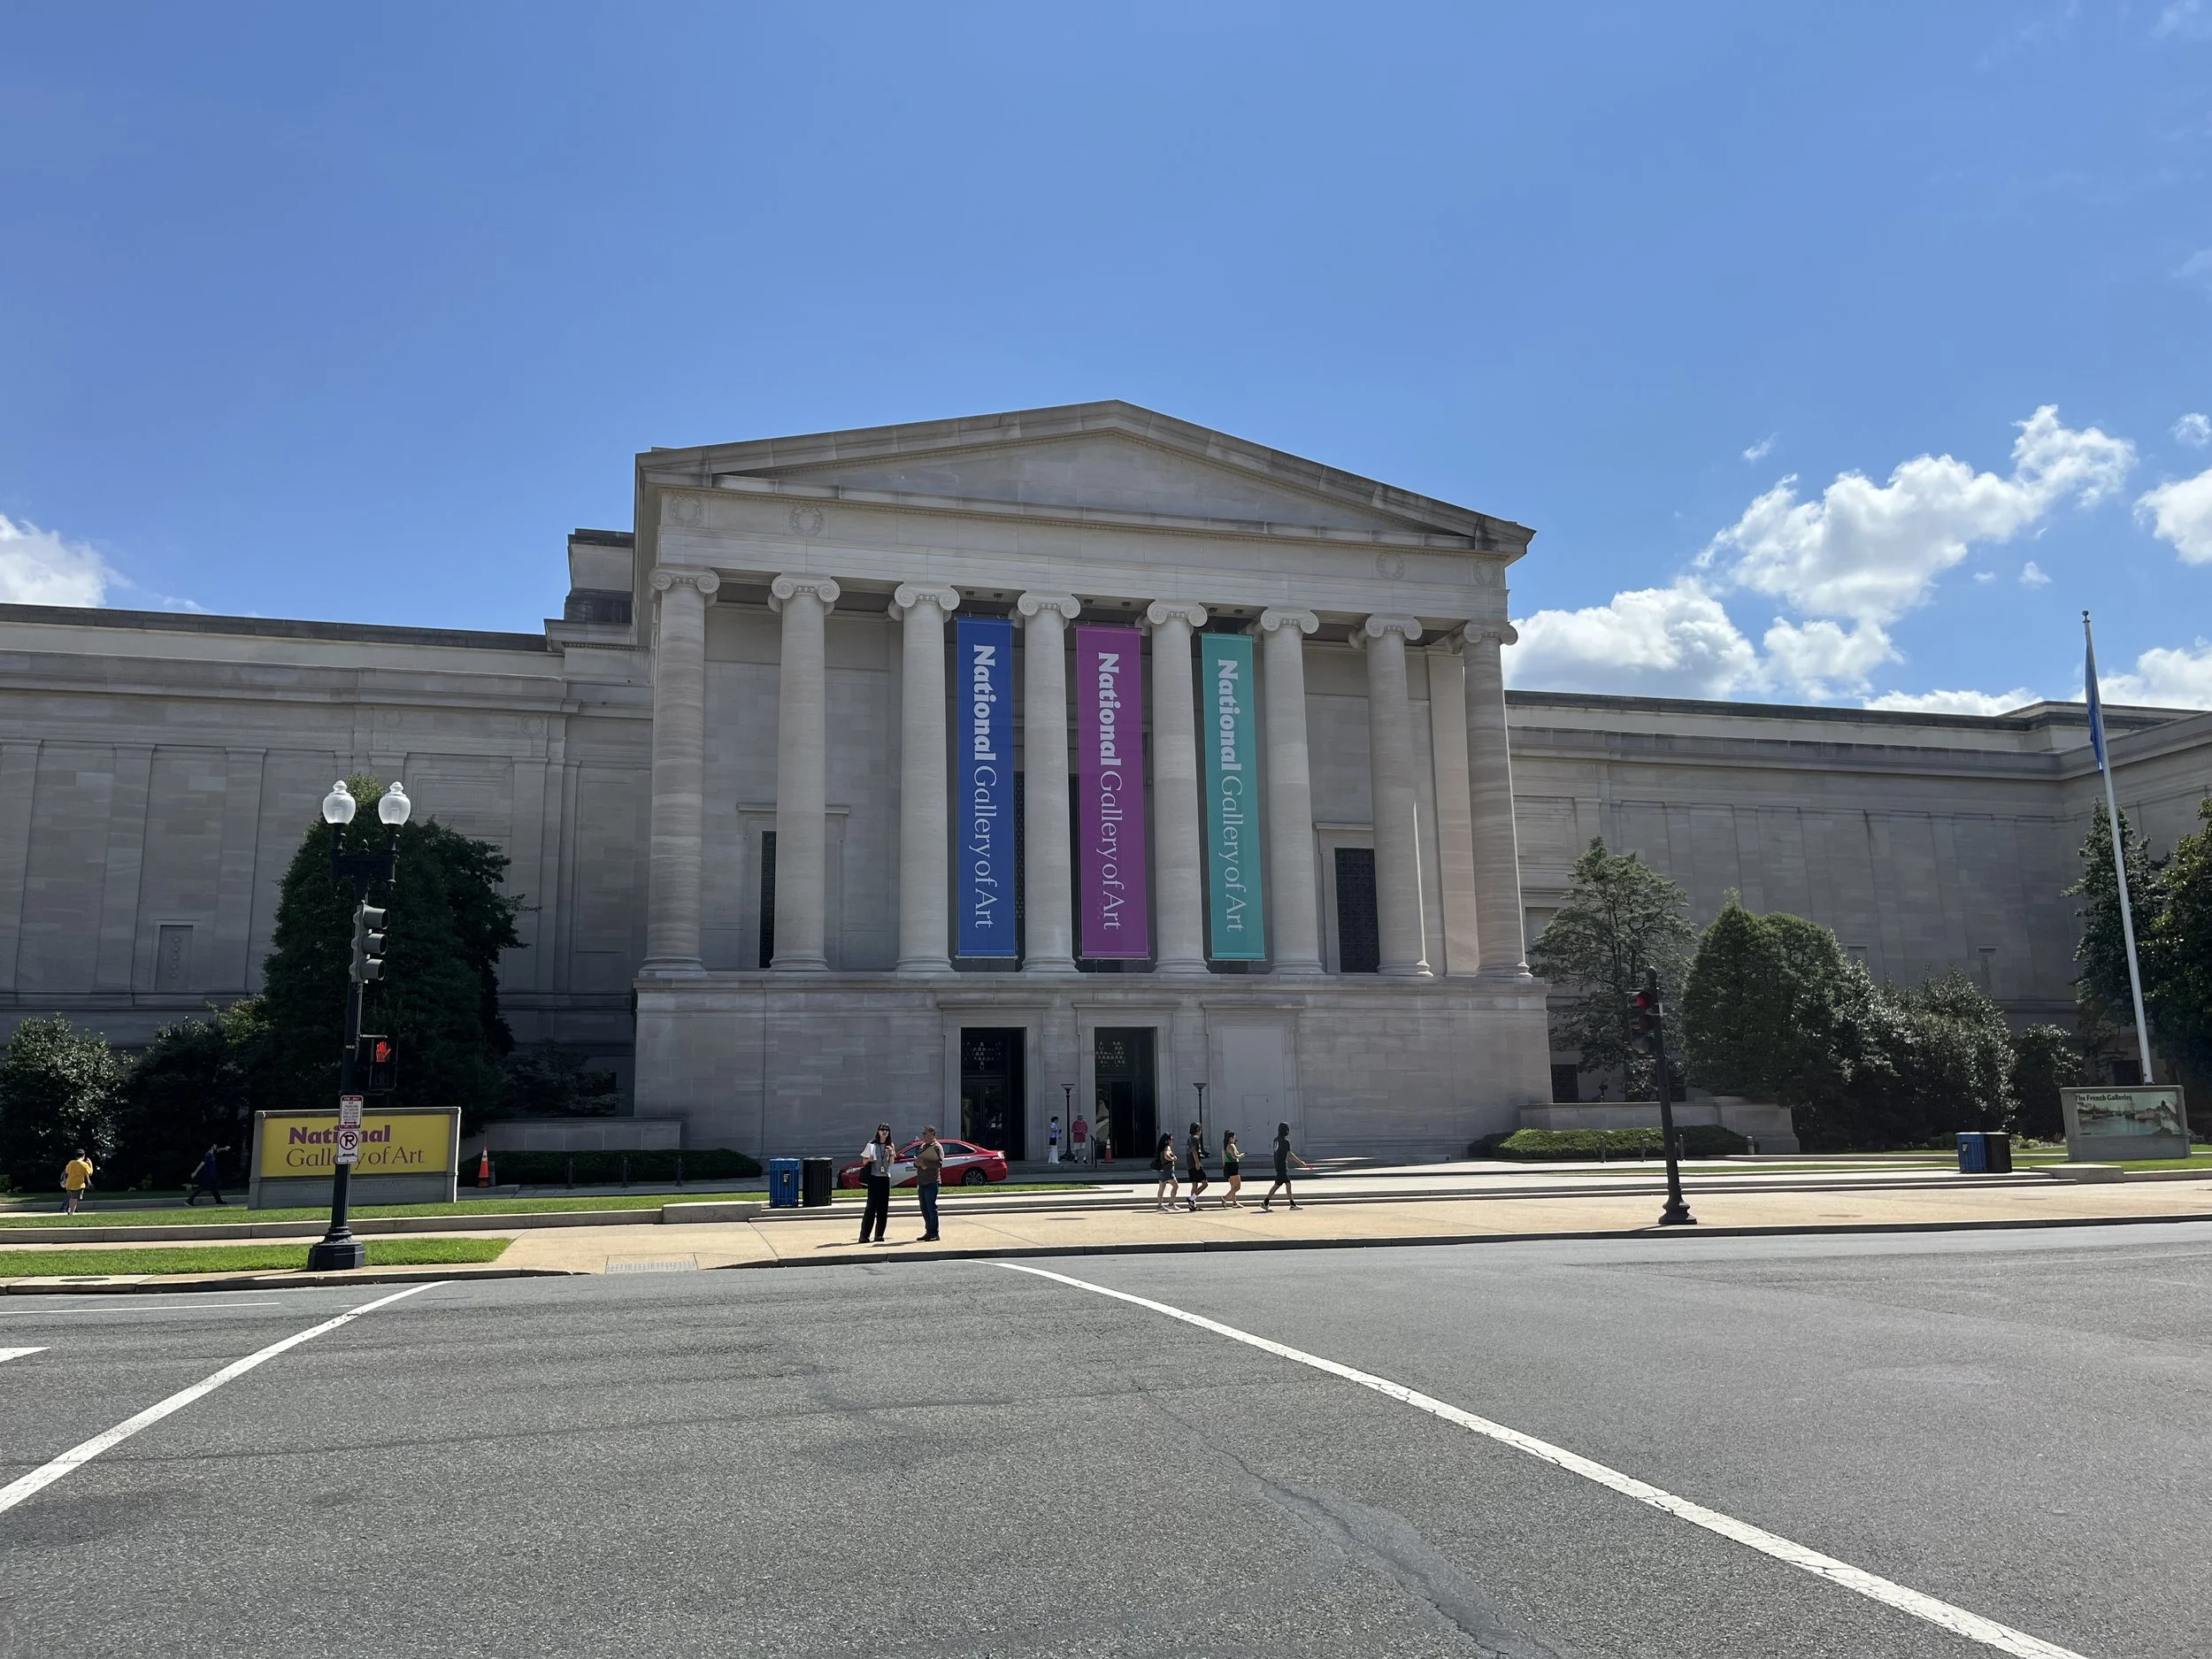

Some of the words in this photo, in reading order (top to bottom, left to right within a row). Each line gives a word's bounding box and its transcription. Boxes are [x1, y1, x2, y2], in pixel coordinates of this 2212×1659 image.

[973, 644, 996, 761] National
[1098, 652, 1122, 767] National
[1217, 658, 1242, 772] National
[969, 765, 997, 858] Gallery
[1096, 771, 1123, 862] Gallery
[1218, 776, 1244, 864] Gallery
[975, 860, 998, 887] of
[1102, 863, 1125, 890] of
[1224, 865, 1246, 893] of
[975, 888, 998, 928] Art
[1102, 890, 1125, 930] Art
[1225, 894, 1248, 933] Art
[288, 1125, 391, 1145] Natinal
[286, 1148, 365, 1171] Gally
[368, 1146, 391, 1165] of
[393, 1147, 424, 1164] Art
